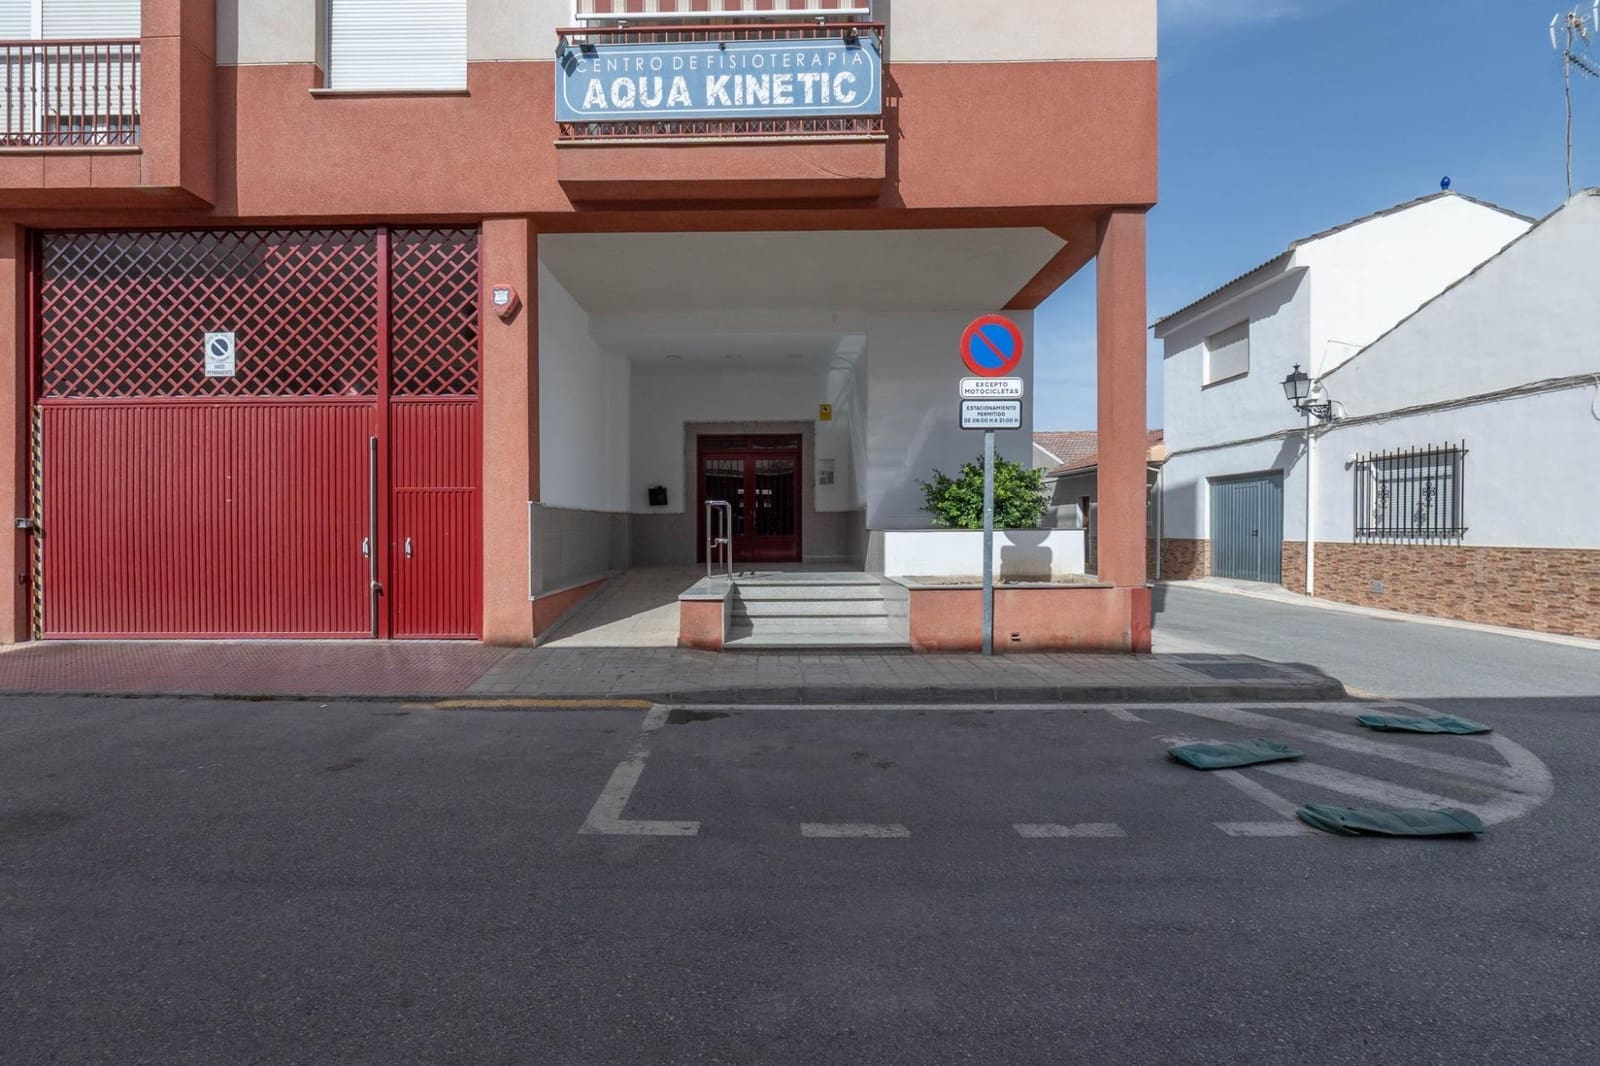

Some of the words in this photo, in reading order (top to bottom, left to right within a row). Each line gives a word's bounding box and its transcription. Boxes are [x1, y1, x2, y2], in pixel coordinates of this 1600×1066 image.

[576, 56, 663, 73] CENTRO
[672, 55, 697, 70] DE
[707, 52, 863, 70] FISIOTERAPIA
[582, 75, 693, 109] AQUA
[706, 71, 857, 107] KINETIC
